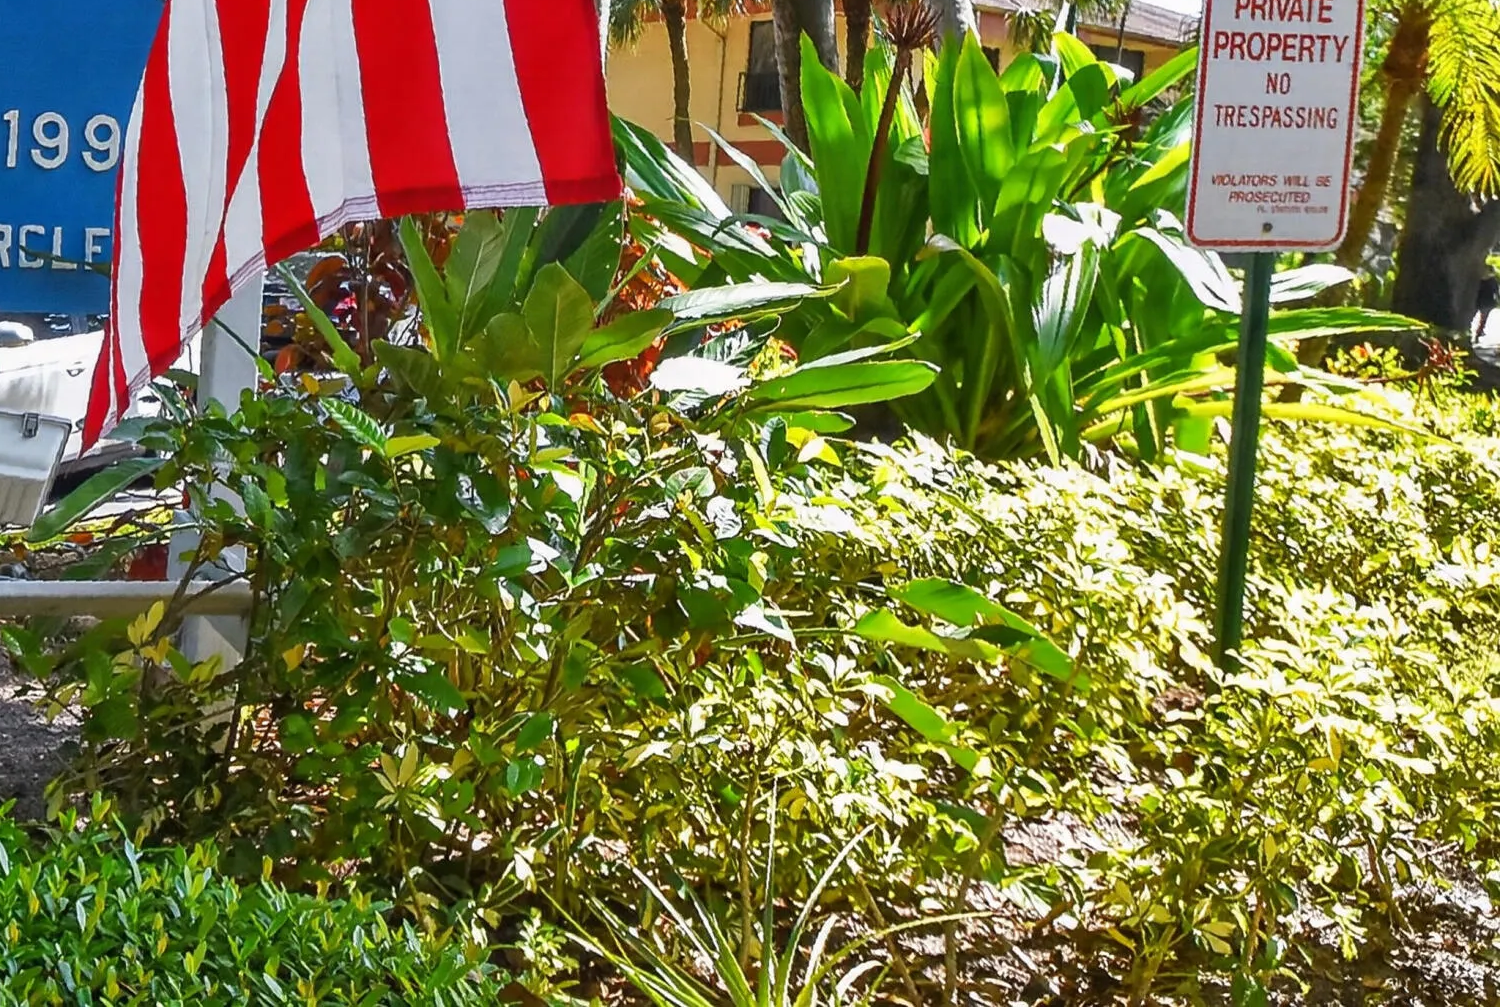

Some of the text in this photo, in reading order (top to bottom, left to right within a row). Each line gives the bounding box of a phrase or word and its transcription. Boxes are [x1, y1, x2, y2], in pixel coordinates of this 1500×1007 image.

[1213, 31, 1349, 63] PROPERTY
[1266, 72, 1291, 95] NO
[1214, 104, 1338, 129] TRESPASSING
[1211, 174, 1332, 187] VIOLATORS WILL BE
[1228, 191, 1311, 203] PROSECUTED
